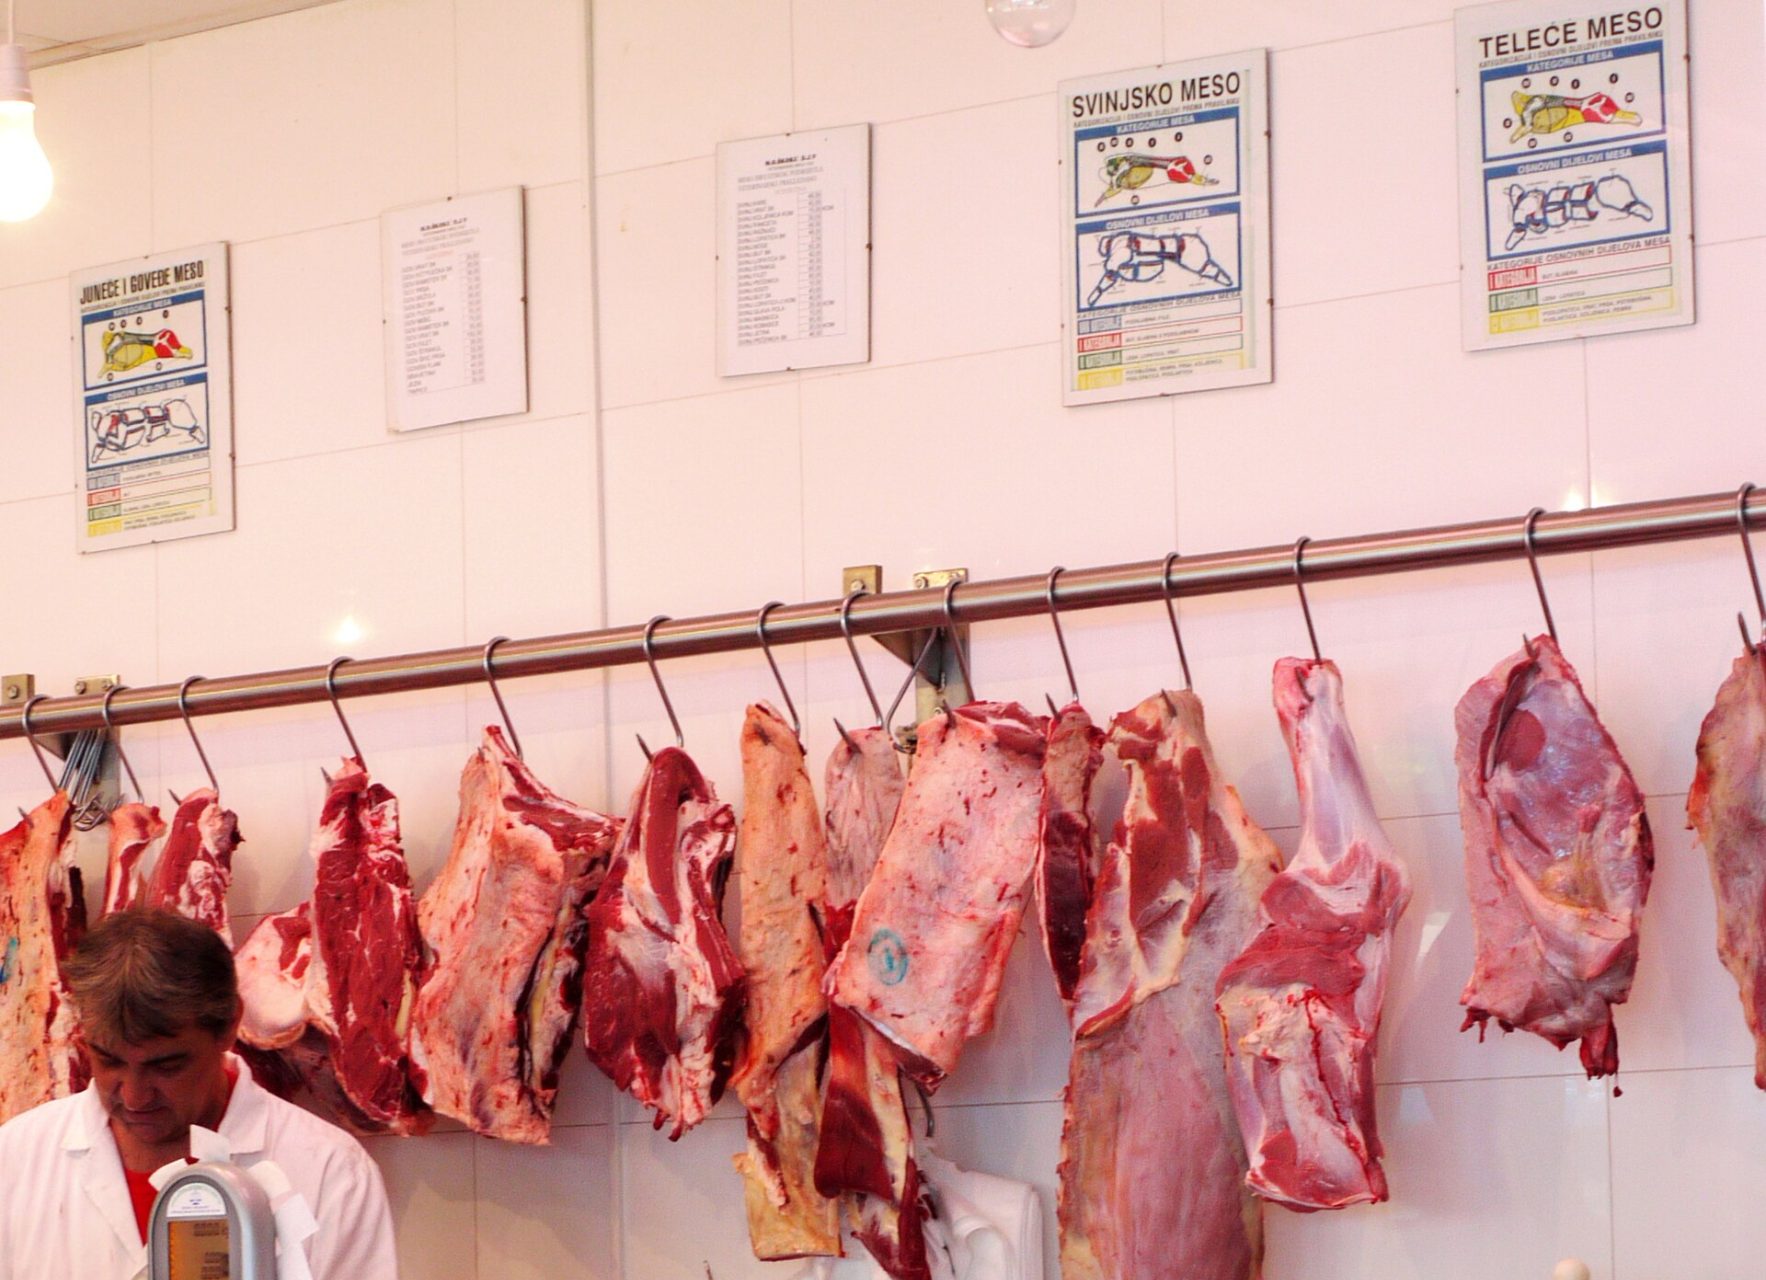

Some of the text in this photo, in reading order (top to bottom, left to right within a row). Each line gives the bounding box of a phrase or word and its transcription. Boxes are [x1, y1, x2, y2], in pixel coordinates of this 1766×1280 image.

[1587, 7, 1663, 40] MESO
[1527, 49, 1614, 72] KATEGORIJE MESA
[1072, 72, 1240, 118] SVINJSKO MESO
[1116, 114, 1195, 133] KATEGORIJE MESA
[1517, 160, 1560, 174] OSNOVNI
[1605, 148, 1633, 160] MESA
[1185, 208, 1210, 219] MESA
[1488, 236, 1671, 270] KATEGORIJE OSNOVNIH DIJELOVA MESA
[123, 277, 127, 295] I
[174, 259, 204, 283] MESO
